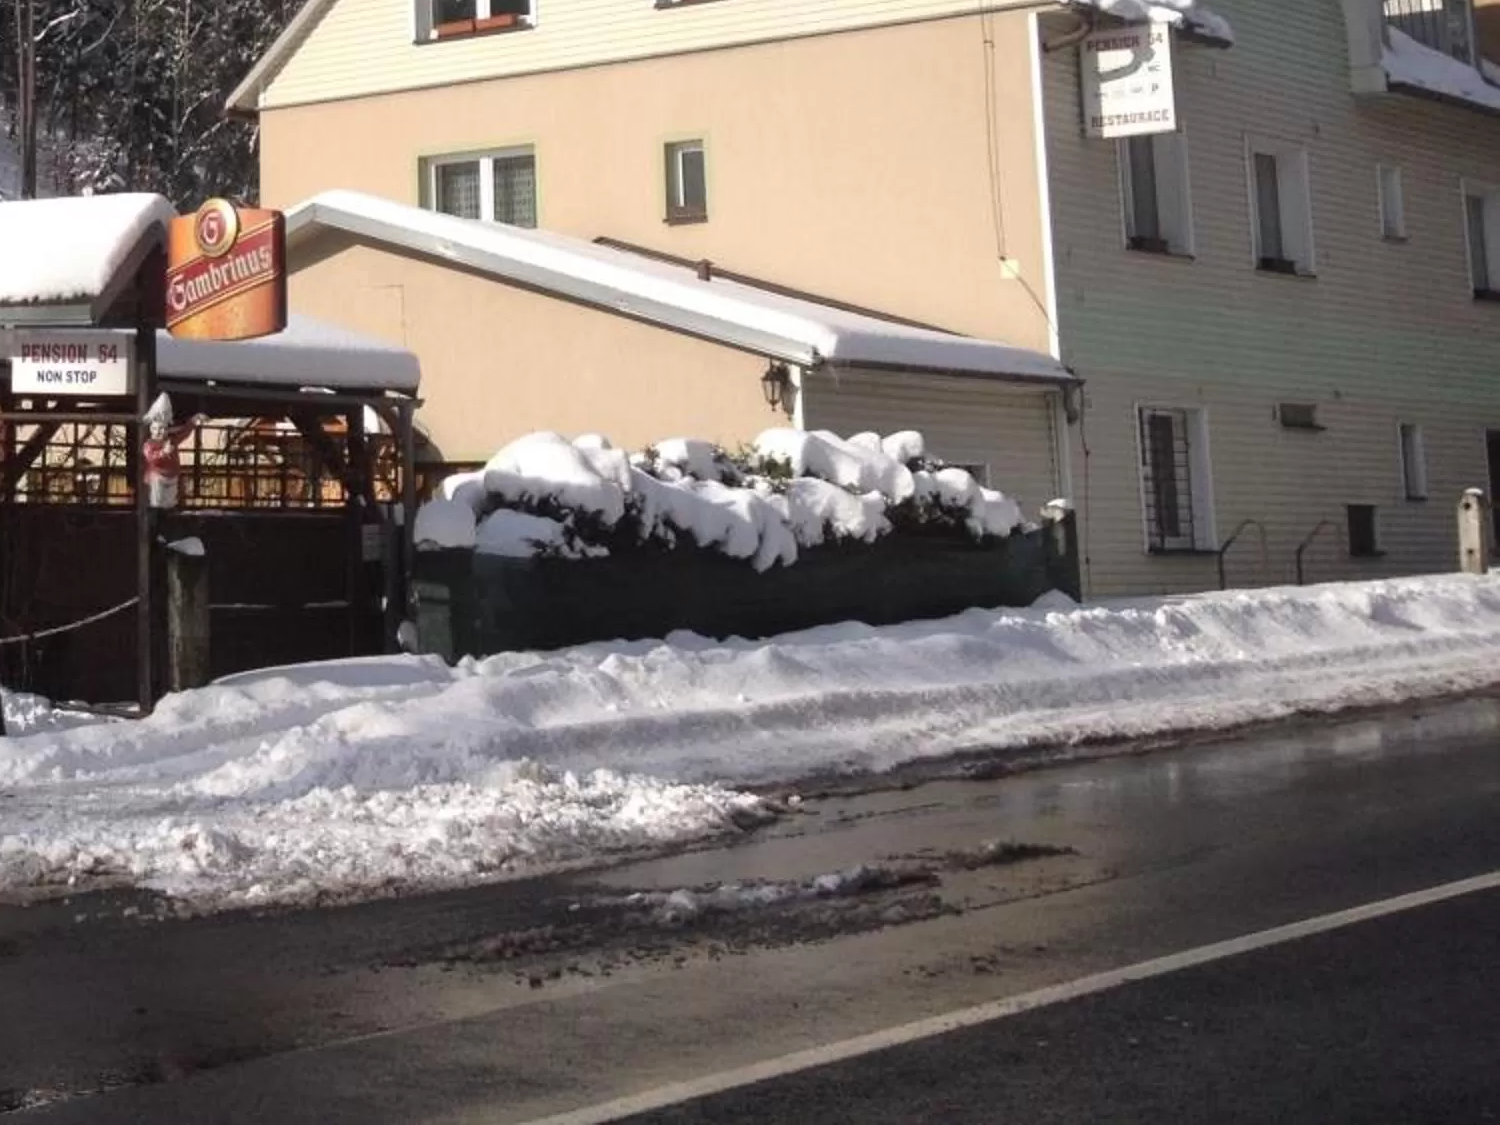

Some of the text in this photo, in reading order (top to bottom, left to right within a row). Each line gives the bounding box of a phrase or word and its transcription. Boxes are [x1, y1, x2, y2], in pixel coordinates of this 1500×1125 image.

[1091, 108, 1170, 128] RESTAURACE
[167, 247, 272, 311] Gambrinus
[21, 343, 118, 364] PENSION 54
[37, 370, 97, 384] NON STOP
